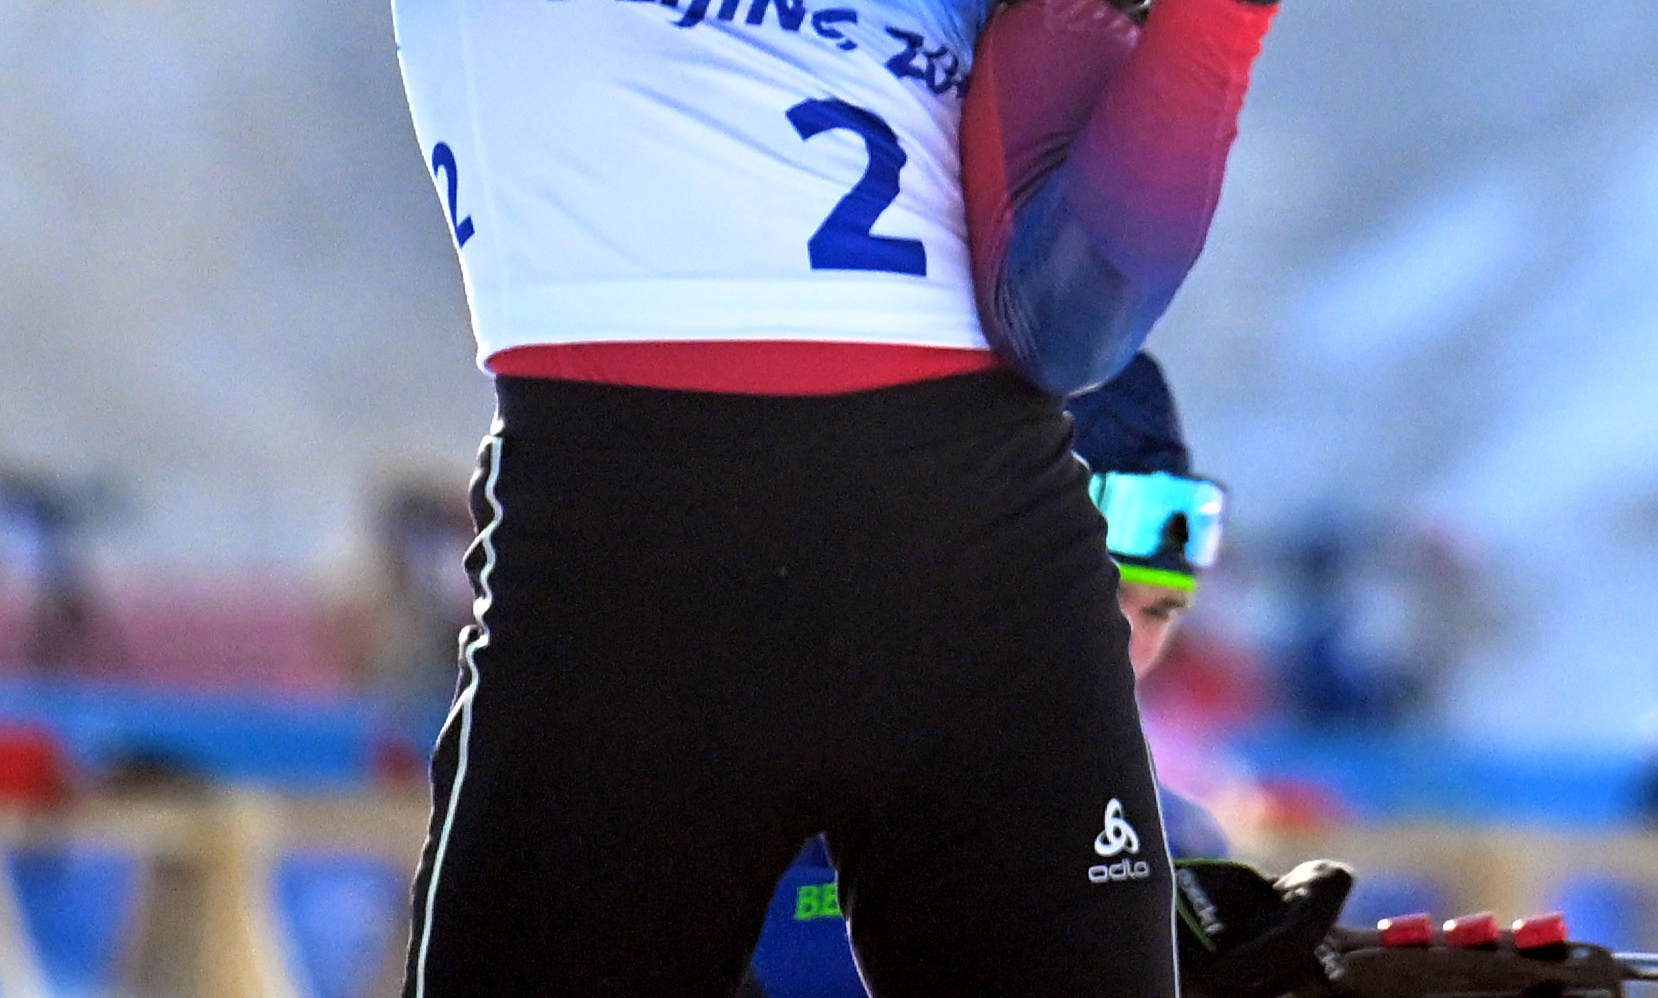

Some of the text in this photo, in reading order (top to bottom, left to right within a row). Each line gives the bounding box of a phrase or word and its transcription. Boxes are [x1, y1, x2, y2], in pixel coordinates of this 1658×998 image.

[885, 25, 970, 98] 20
[431, 141, 475, 249] 2
[785, 97, 927, 276] 2
[1088, 858, 1149, 883] odlo
